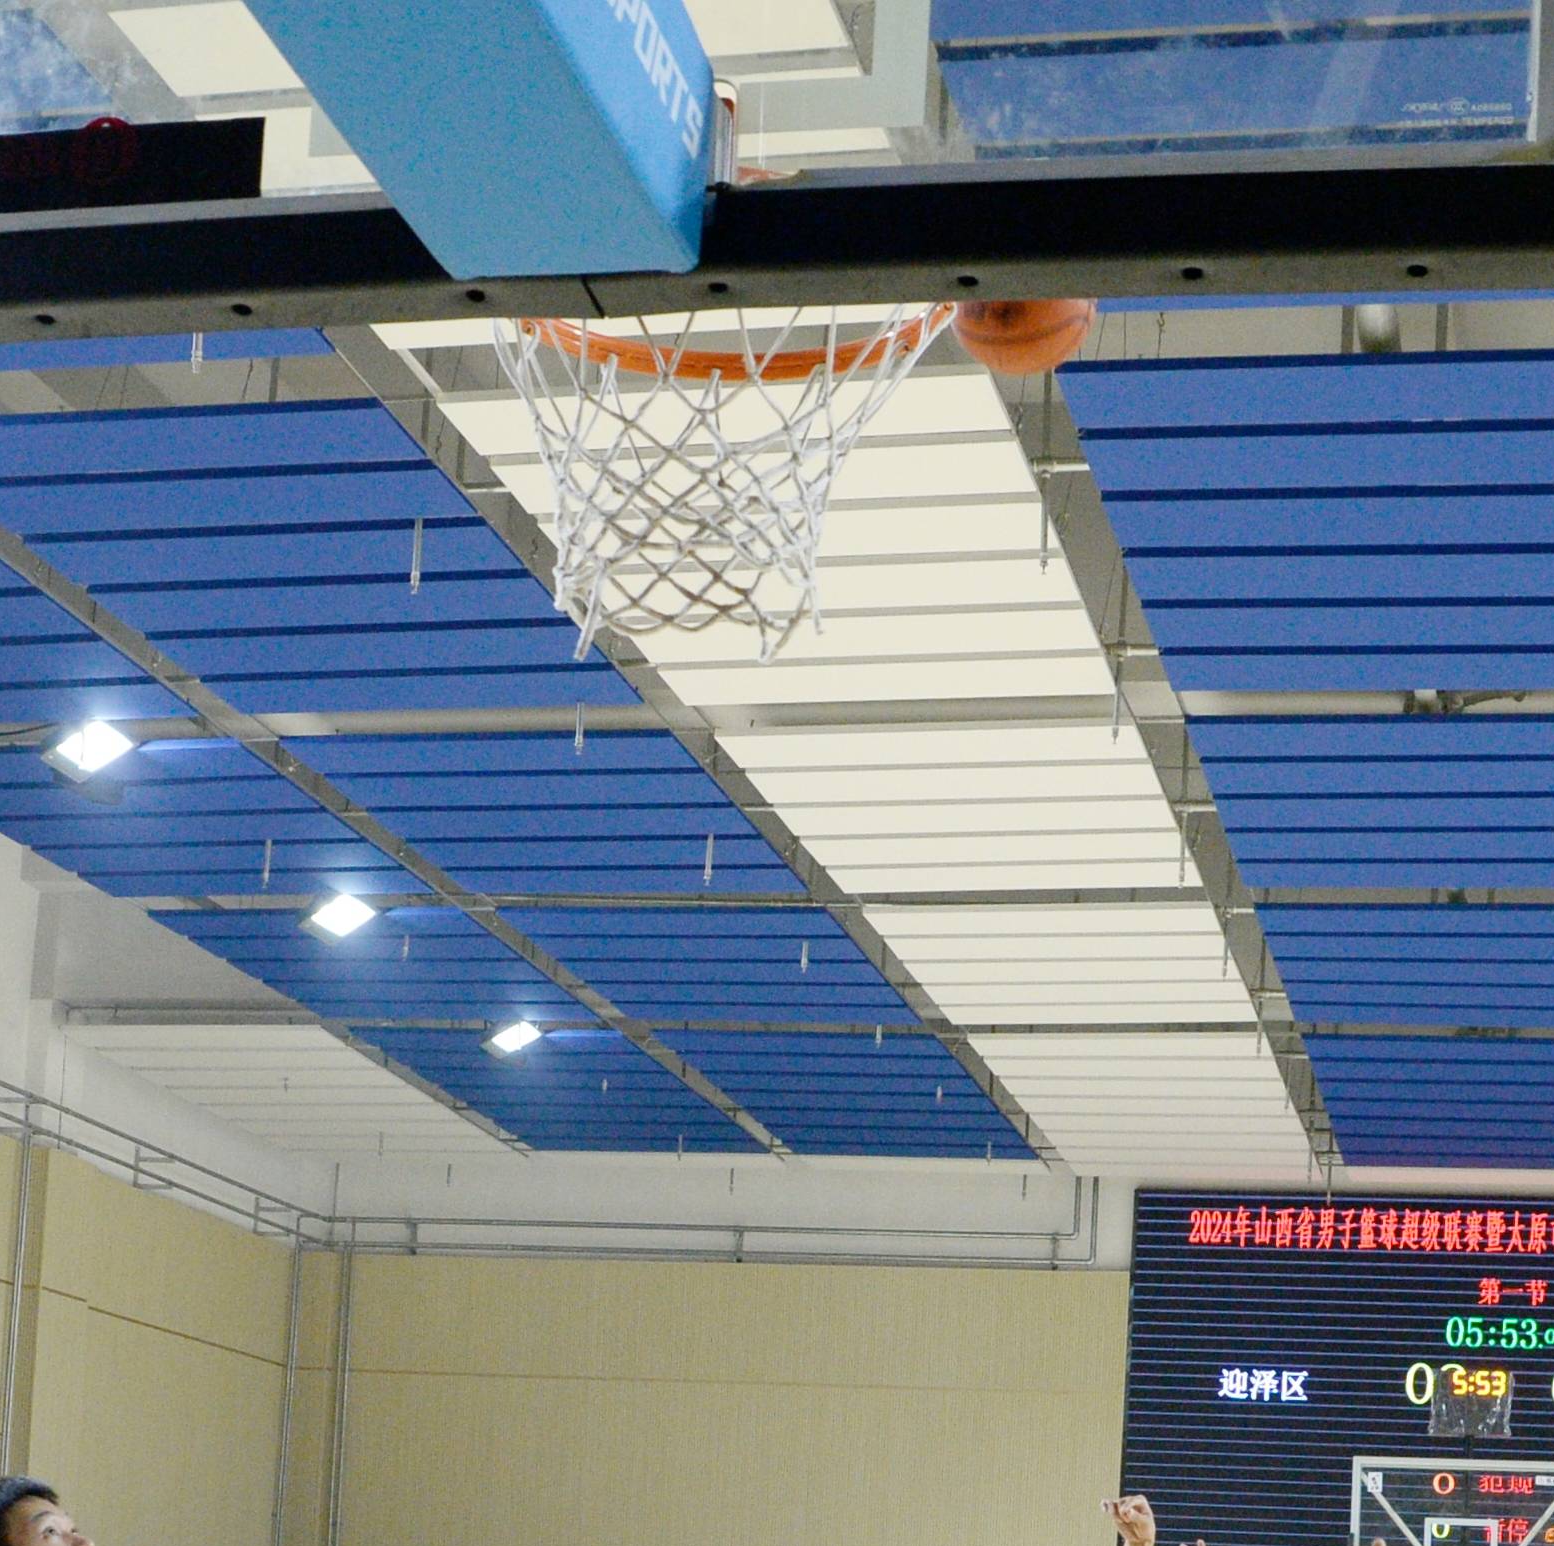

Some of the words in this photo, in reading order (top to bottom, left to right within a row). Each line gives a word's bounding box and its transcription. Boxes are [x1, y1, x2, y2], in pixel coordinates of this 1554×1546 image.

[1479, 1278, 1548, 1306] 第一节
[1218, 1368, 1309, 1402] 迎泽区
[1452, 1369, 1508, 1397] 5:53
